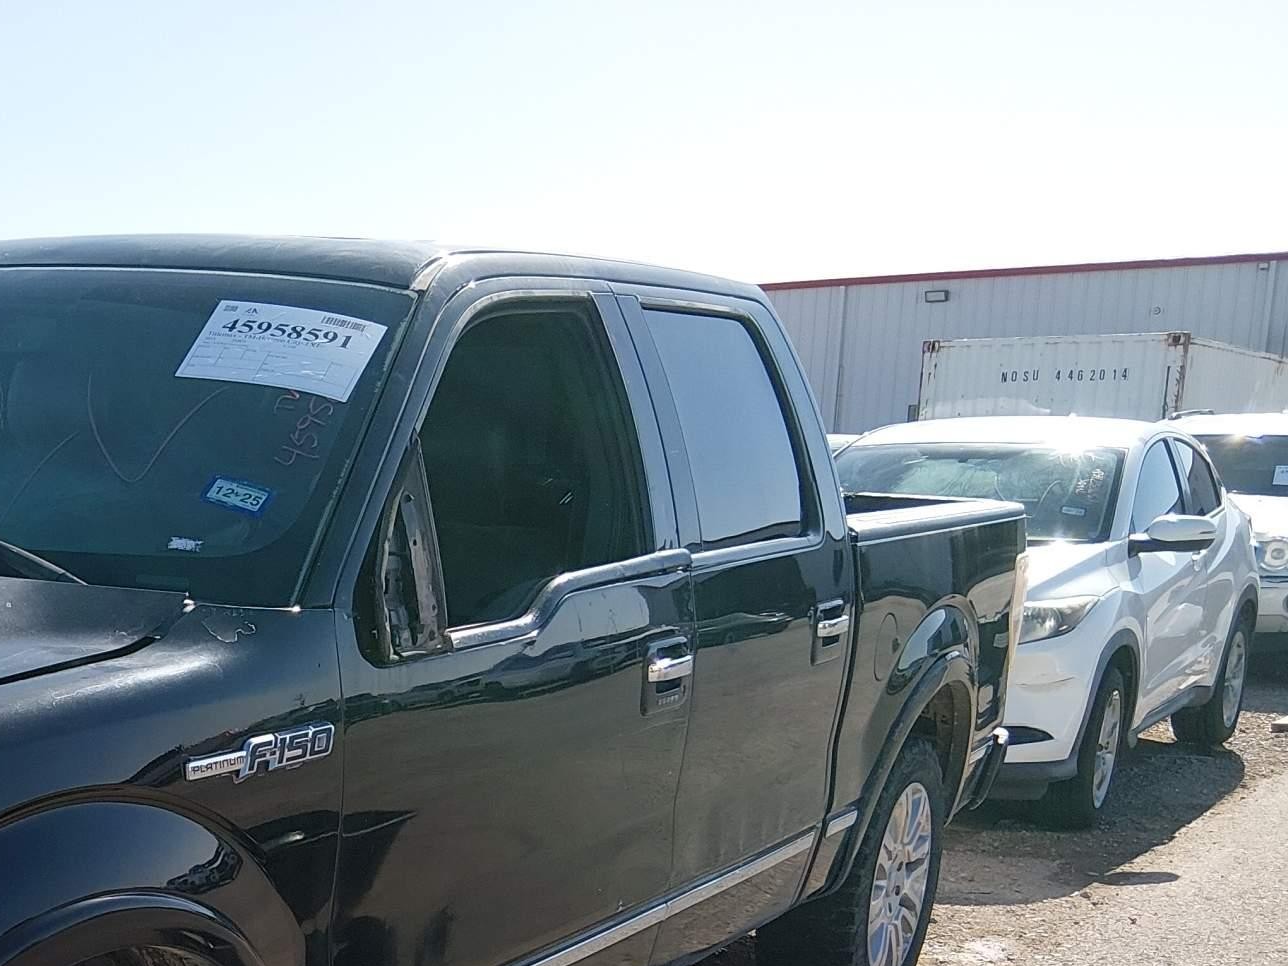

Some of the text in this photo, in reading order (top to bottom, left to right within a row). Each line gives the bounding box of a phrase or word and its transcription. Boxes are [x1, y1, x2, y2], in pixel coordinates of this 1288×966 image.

[222, 318, 353, 349] 45958591
[1001, 367, 1129, 383] NOSU 4462014
[191, 723, 334, 777] PLATINUM F-150
